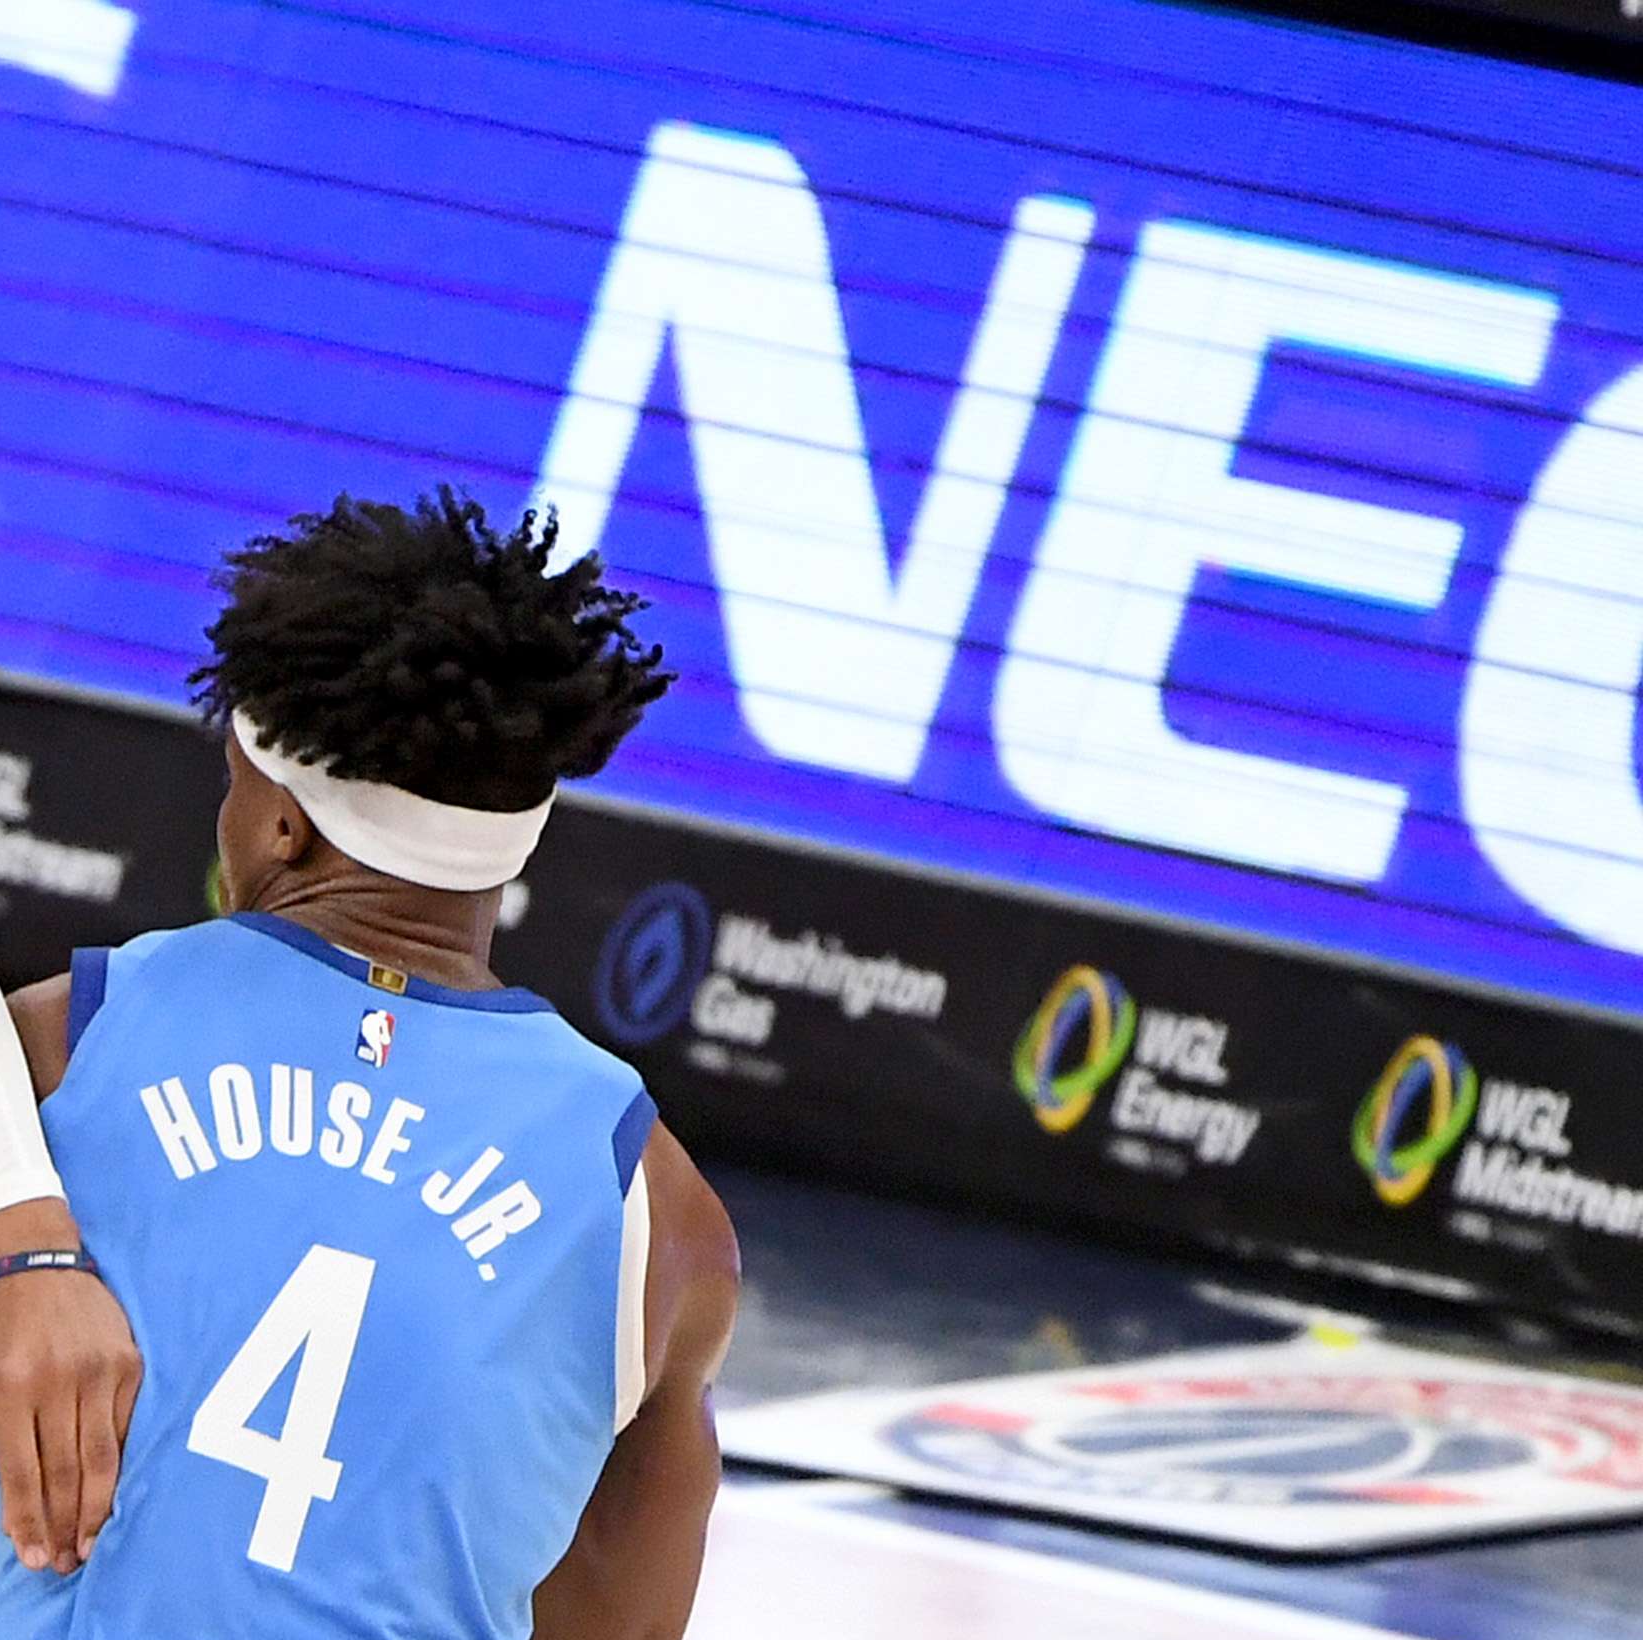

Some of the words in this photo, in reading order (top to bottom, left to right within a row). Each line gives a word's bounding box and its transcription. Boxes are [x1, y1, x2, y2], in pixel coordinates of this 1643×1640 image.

[690, 972, 776, 1047] Gas
[717, 911, 948, 1023] Washington
[1137, 1007, 1229, 1087] WGL
[1111, 1064, 1262, 1166] Energy
[1476, 1078, 1573, 1158] WGL
[139, 1062, 426, 1186] HOUSE
[420, 1145, 542, 1281] JR.
[186, 1242, 377, 1573] 4
